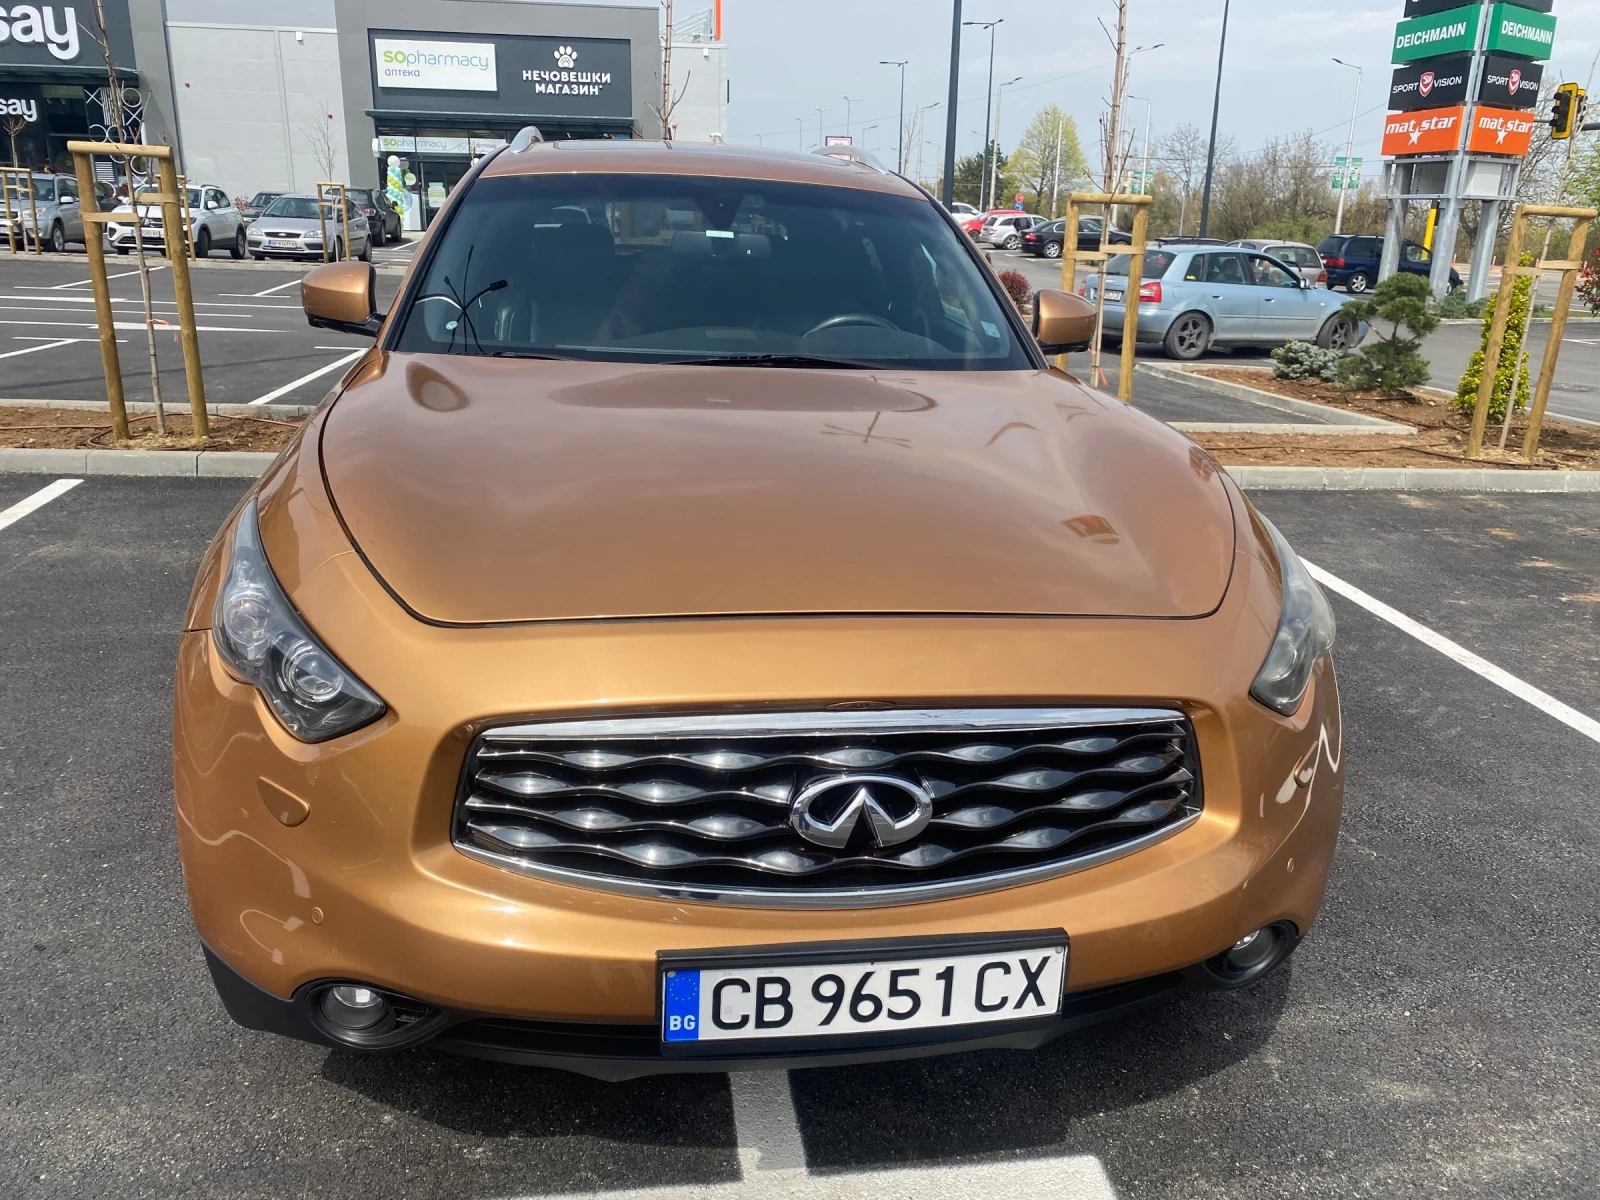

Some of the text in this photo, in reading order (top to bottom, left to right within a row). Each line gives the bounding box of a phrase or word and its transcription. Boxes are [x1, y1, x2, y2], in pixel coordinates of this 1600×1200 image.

[1396, 21, 1467, 49] DEICHMANN
[1501, 20, 1553, 44] DEICHMANN
[384, 68, 420, 77] аптека
[522, 69, 611, 84] НЕЧОВЕШКИ
[1392, 76, 1463, 94] SPORT VISION
[1486, 75, 1538, 91] SPORT VISION
[1385, 116, 1458, 135] mat star
[1478, 116, 1533, 134] mat star
[711, 955, 1052, 1031] CB 9651 CX
[669, 1015, 696, 1033] BG
